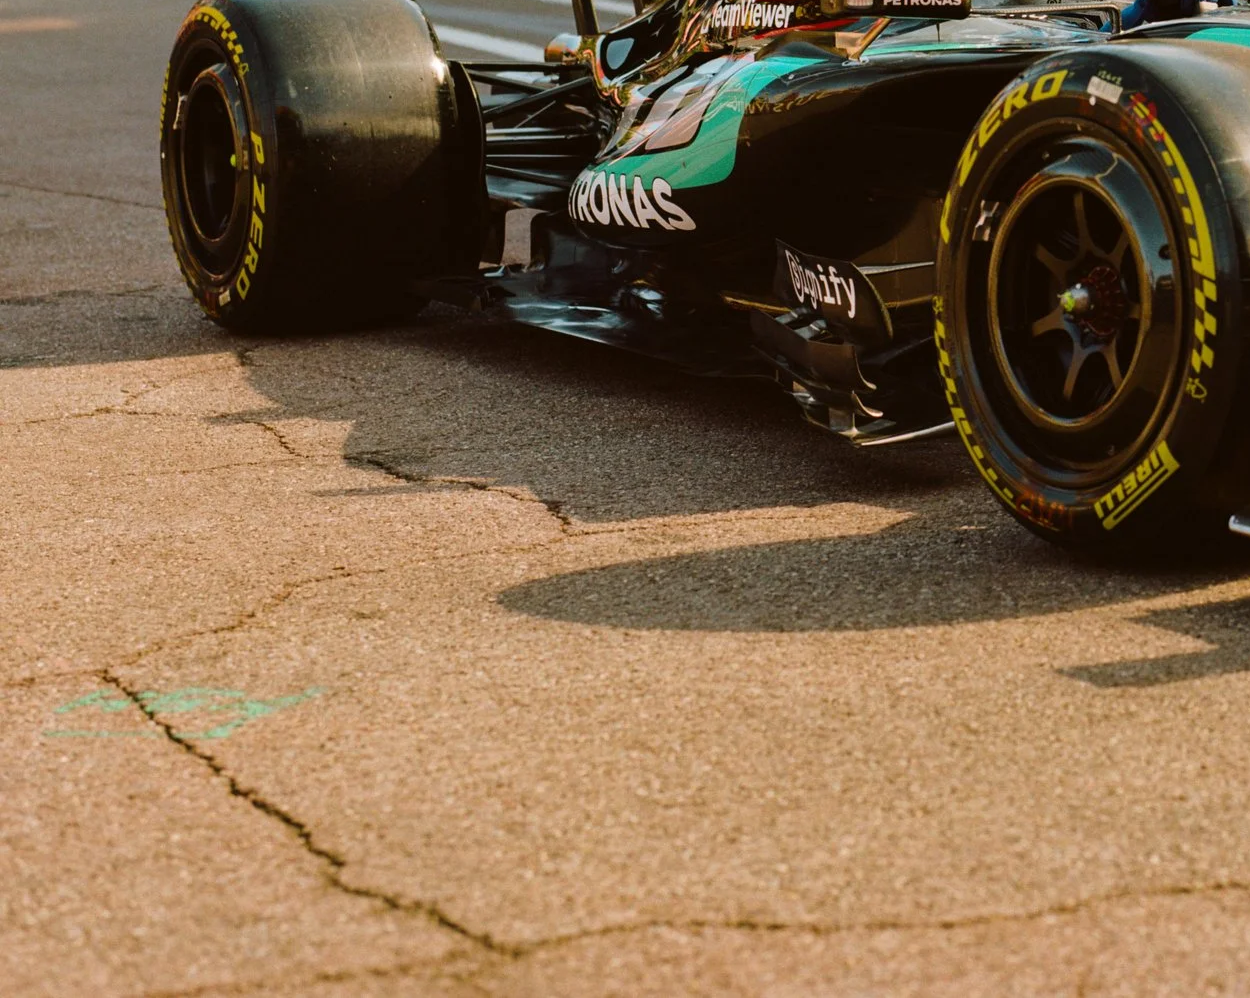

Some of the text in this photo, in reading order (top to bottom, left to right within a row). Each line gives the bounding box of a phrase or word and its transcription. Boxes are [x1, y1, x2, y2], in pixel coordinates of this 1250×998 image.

[958, 69, 1069, 187] ZERO
[236, 130, 266, 300] P ZERO
[1093, 439, 1180, 531] PIRELLI
